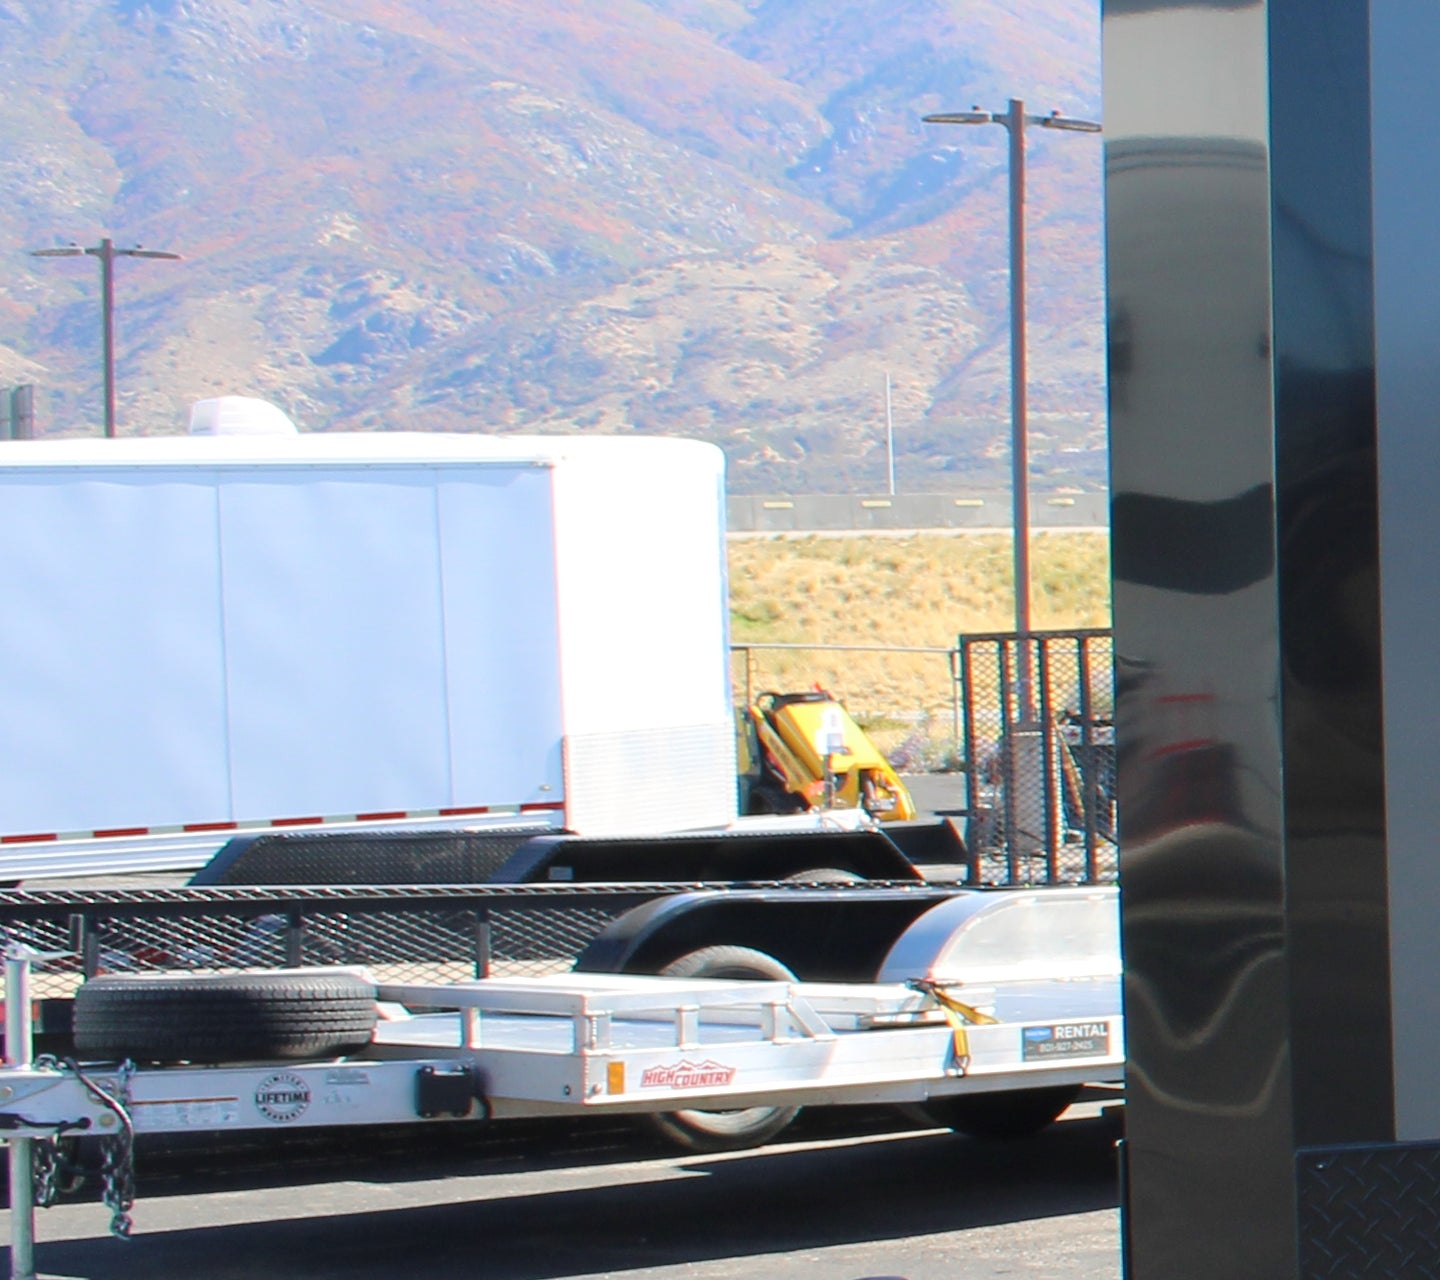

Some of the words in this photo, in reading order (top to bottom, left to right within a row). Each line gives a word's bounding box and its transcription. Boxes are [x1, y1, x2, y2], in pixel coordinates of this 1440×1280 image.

[1055, 1023, 1108, 1039] RENTAL
[643, 1070, 675, 1085] HIGH
[674, 1071, 731, 1087] COUNTRY
[256, 1091, 311, 1105] LIFETIME
